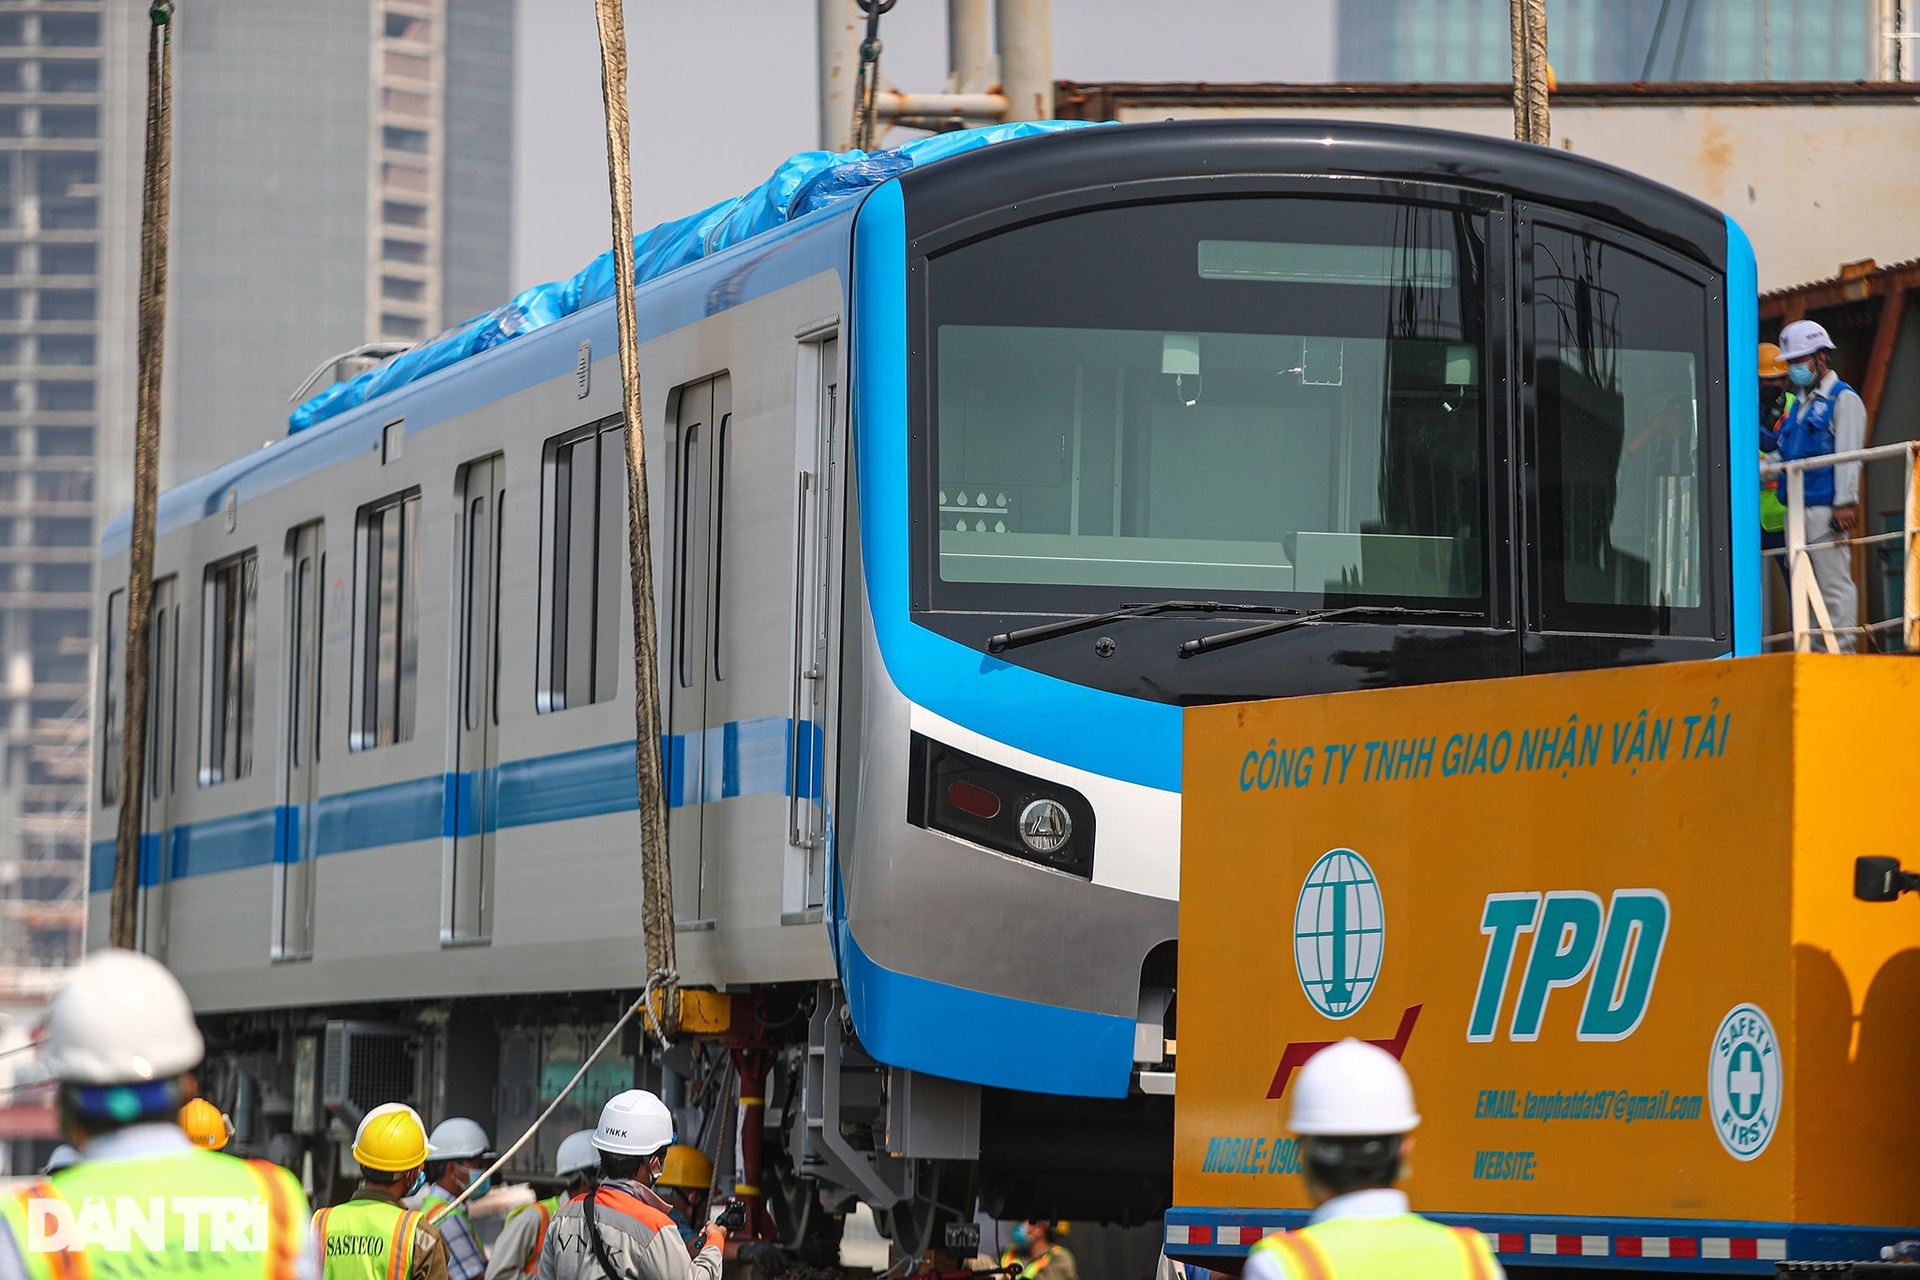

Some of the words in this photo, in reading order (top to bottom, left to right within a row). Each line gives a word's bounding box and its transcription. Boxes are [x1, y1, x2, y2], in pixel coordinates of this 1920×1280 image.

[1239, 737, 1315, 792] CÔNG
[1322, 743, 1357, 785] TY
[1363, 736, 1437, 782] TNHH
[1441, 729, 1512, 778] GIAO
[1515, 713, 1603, 779] NHẬN
[1611, 708, 1674, 776] VẬN
[1681, 697, 1731, 759] TẢI
[1466, 888, 1671, 1043] TPD
[1720, 1016, 1773, 1057] SAFETY
[1475, 1090, 1521, 1119] EMAIL:
[1523, 1089, 1703, 1123] tanphatdat97@gmail.com
[605, 1126, 628, 1139] VNKK
[1721, 1108, 1768, 1146] FIRST
[1202, 1137, 1267, 1174] MOBILE:
[1473, 1151, 1537, 1180] WEBSITE:
[326, 1234, 384, 1257] SASTECO
[558, 1233, 623, 1269] VNK
